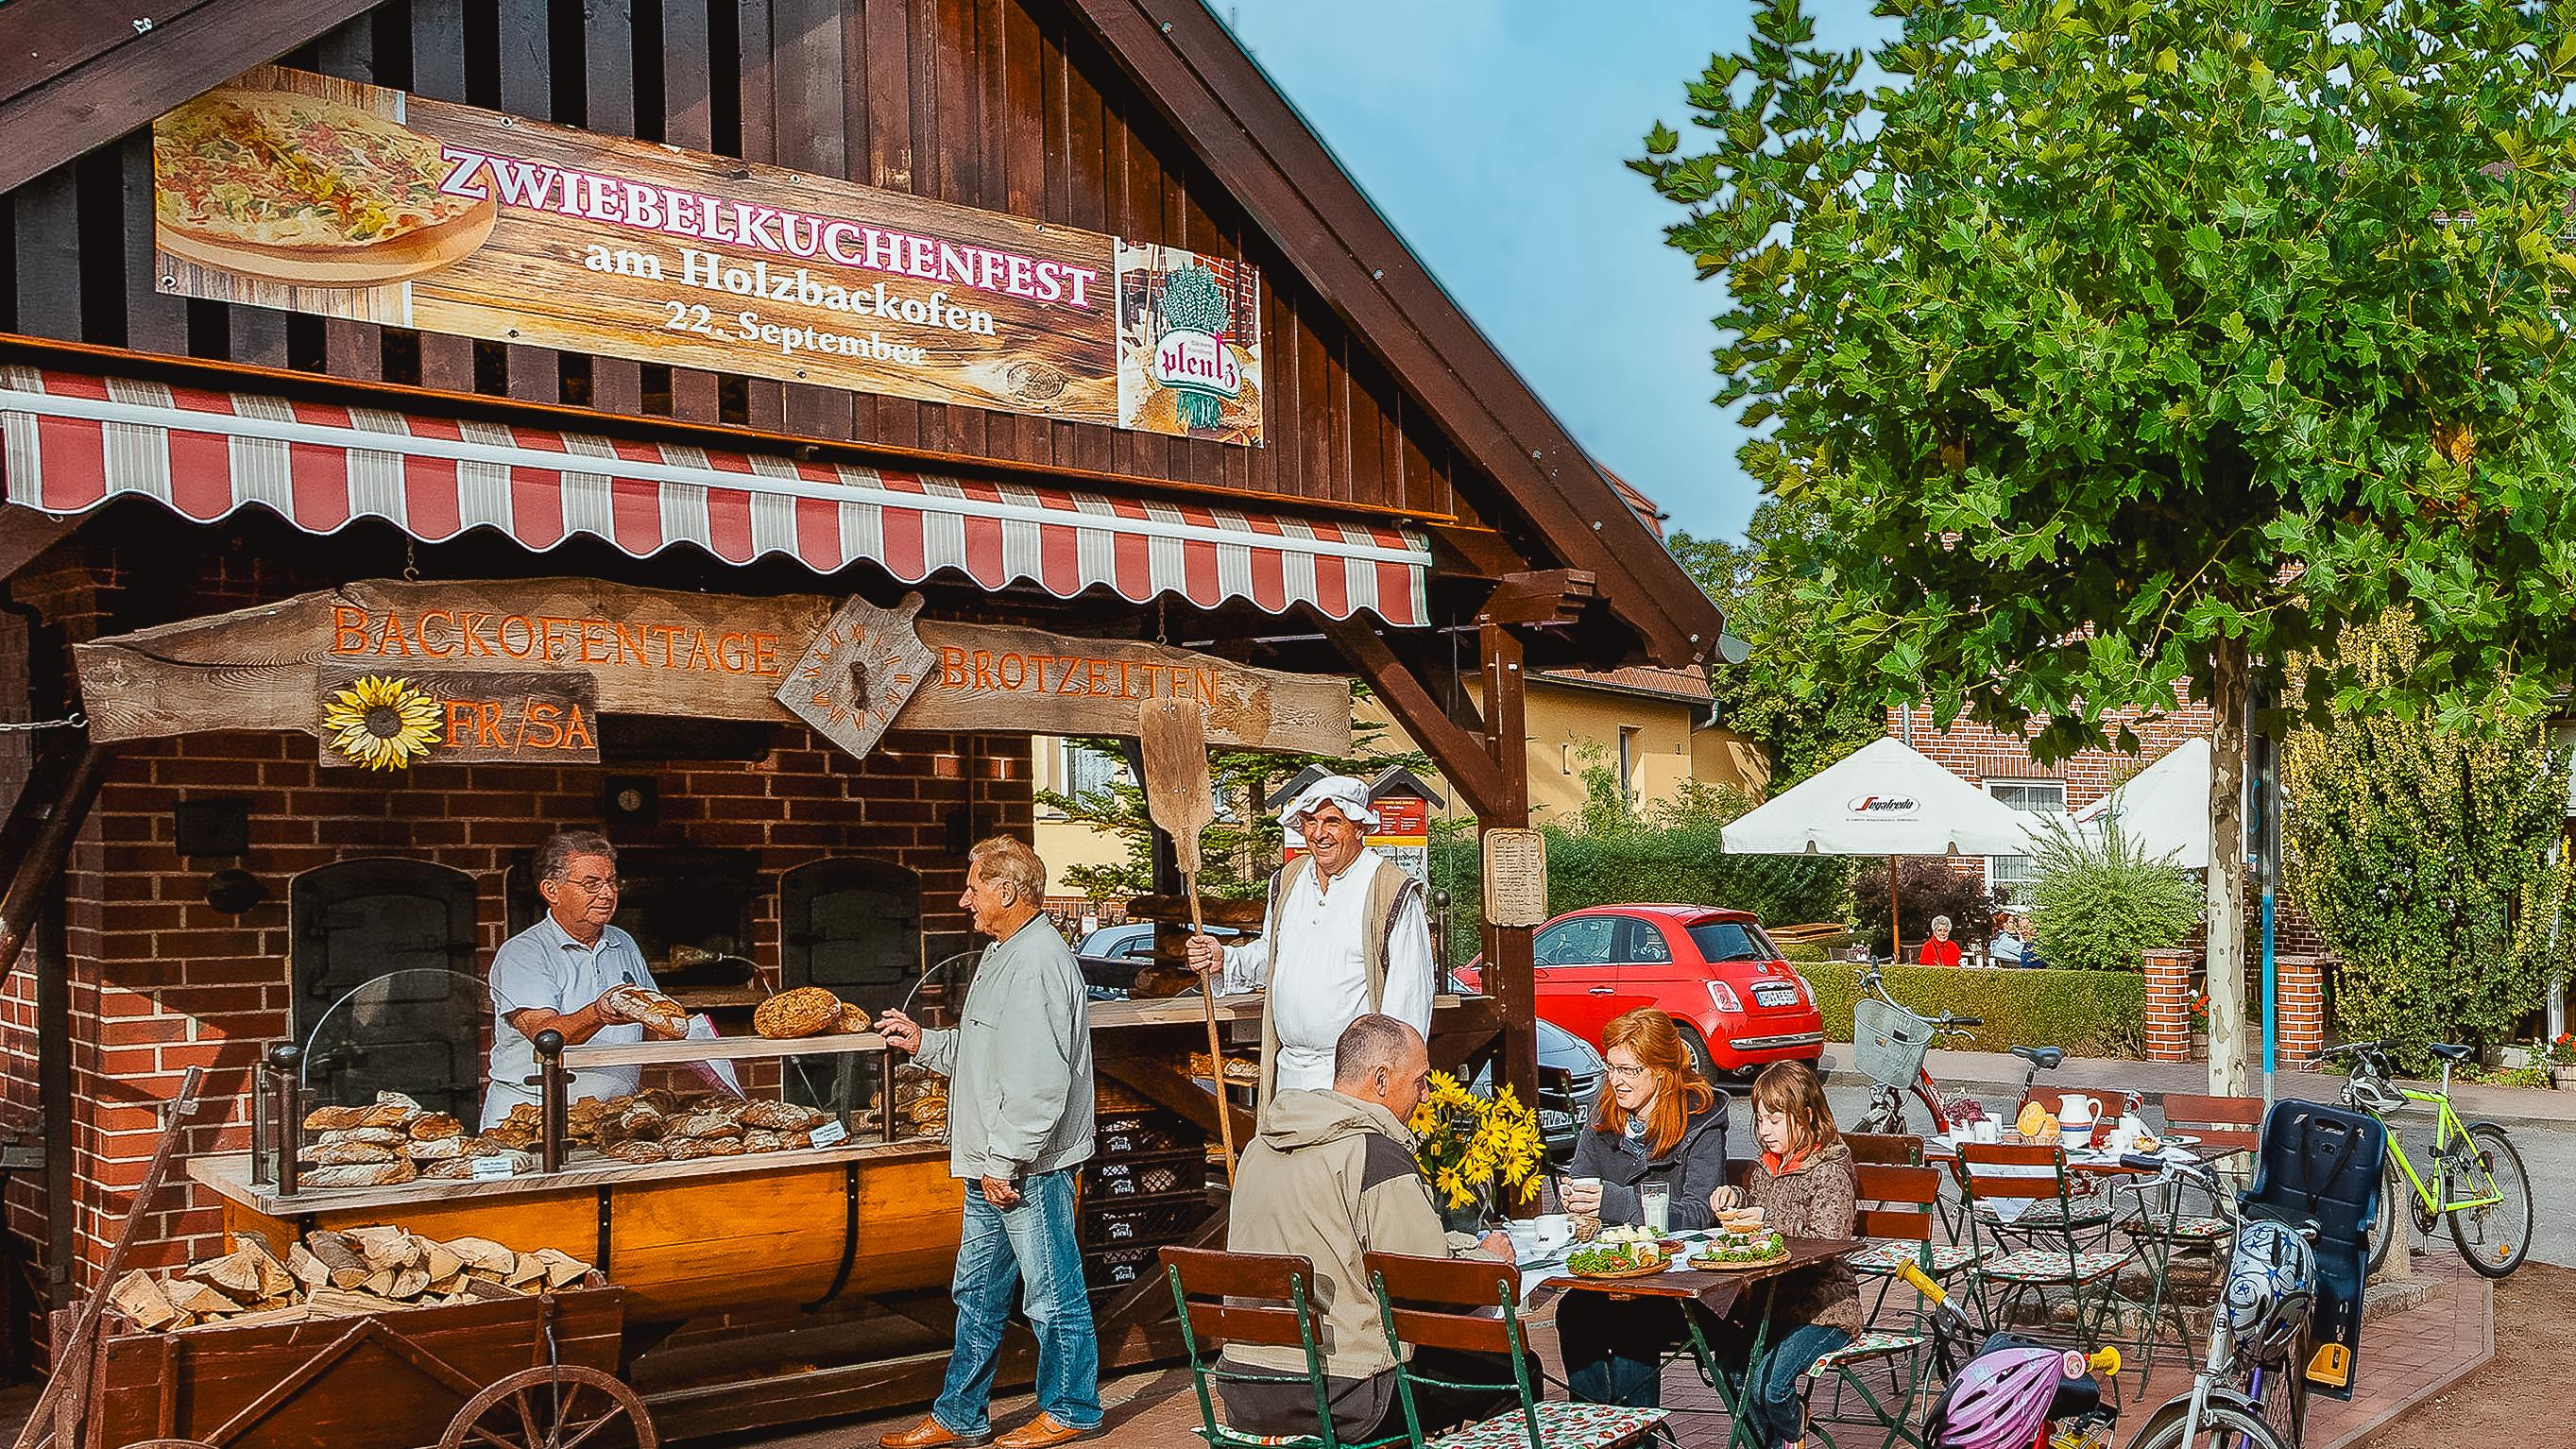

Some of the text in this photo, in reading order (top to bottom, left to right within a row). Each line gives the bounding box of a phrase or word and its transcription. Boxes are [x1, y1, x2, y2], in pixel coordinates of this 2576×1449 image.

[439, 145, 1098, 309] ZWIEBELKUCHENFEST
[584, 244, 997, 336] am Holzbackofen
[664, 300, 928, 367] 22. September
[330, 604, 1220, 707] BACKOFENTAGE BROTZEITEN
[438, 693, 597, 756] FR/SA
